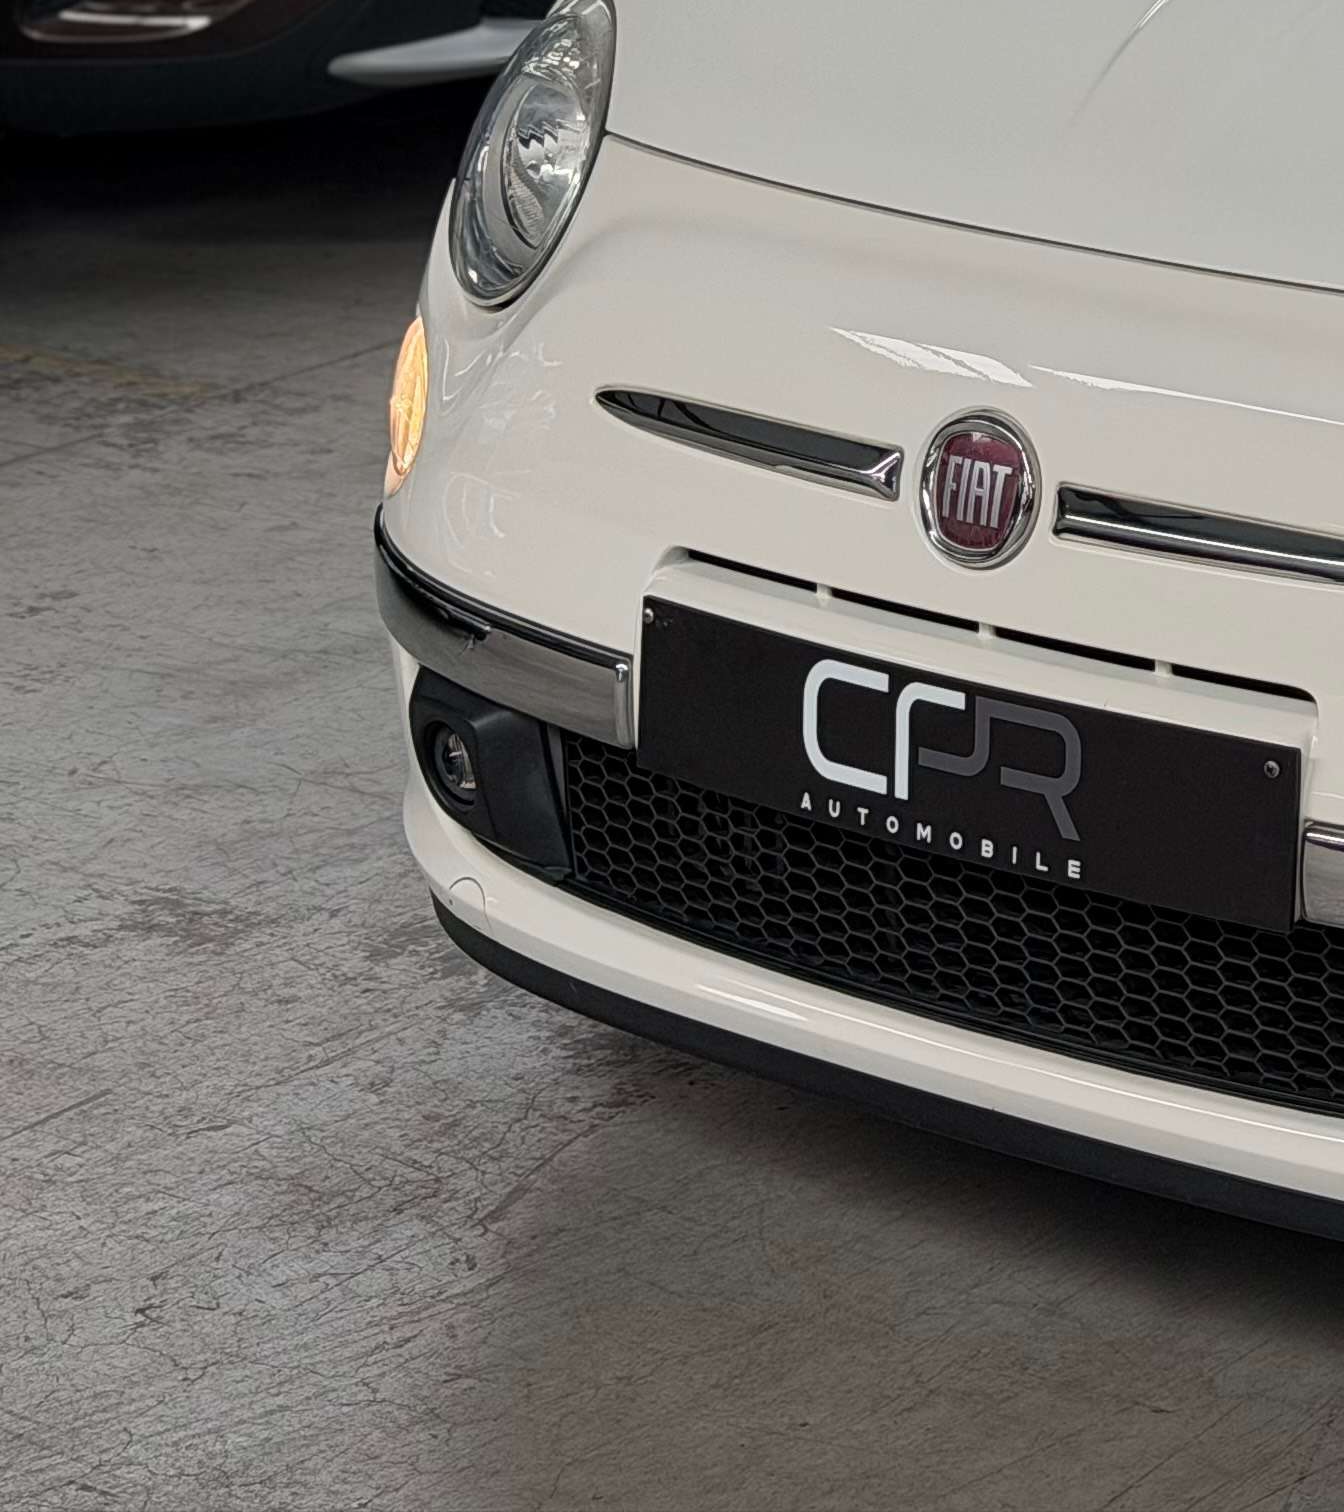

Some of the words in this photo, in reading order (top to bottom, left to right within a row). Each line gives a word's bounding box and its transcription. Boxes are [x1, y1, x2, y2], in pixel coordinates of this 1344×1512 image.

[942, 454, 1013, 529] FIAT
[802, 658, 1082, 842] CPR
[800, 791, 1082, 880] AUTOMOBILE
